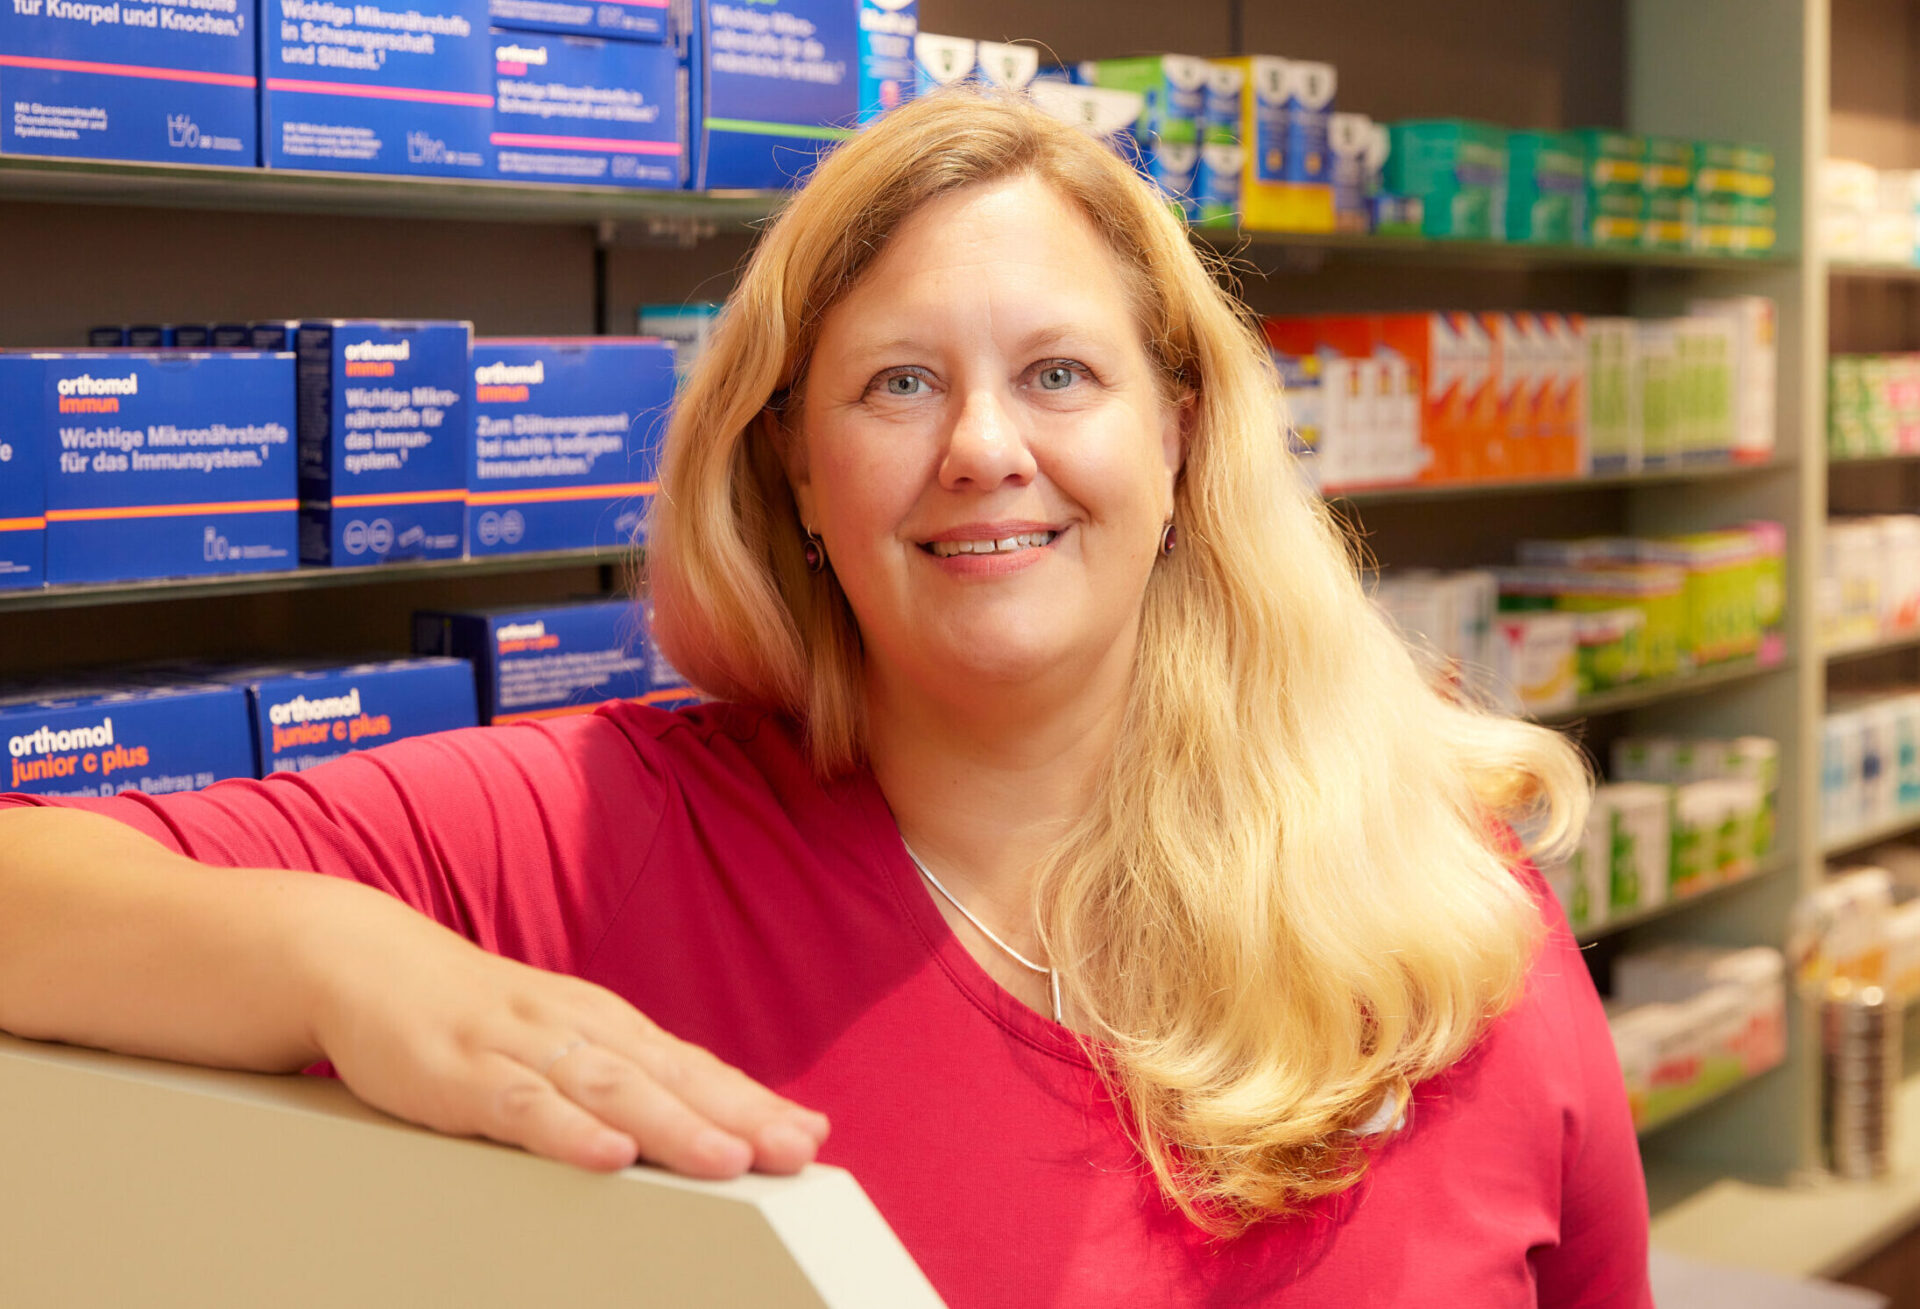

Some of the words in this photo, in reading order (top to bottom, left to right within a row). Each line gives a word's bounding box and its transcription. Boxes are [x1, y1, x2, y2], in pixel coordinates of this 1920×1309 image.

[46, 0, 119, 26] Knorpel
[123, 7, 158, 28] und
[281, 45, 315, 65] und
[57, 372, 138, 395] orthomol
[59, 395, 119, 414] immun
[59, 427, 144, 452] Wichtige
[147, 422, 289, 447] Mikronährstoffe
[60, 451, 88, 473] für
[92, 449, 129, 472] das
[269, 687, 361, 725] orthomol
[9, 717, 113, 757] orthomol
[272, 720, 331, 753] junior
[332, 720, 348, 741] c
[349, 712, 391, 743] plus
[11, 753, 78, 788] junior
[83, 753, 98, 773] c
[102, 744, 149, 775] plus
